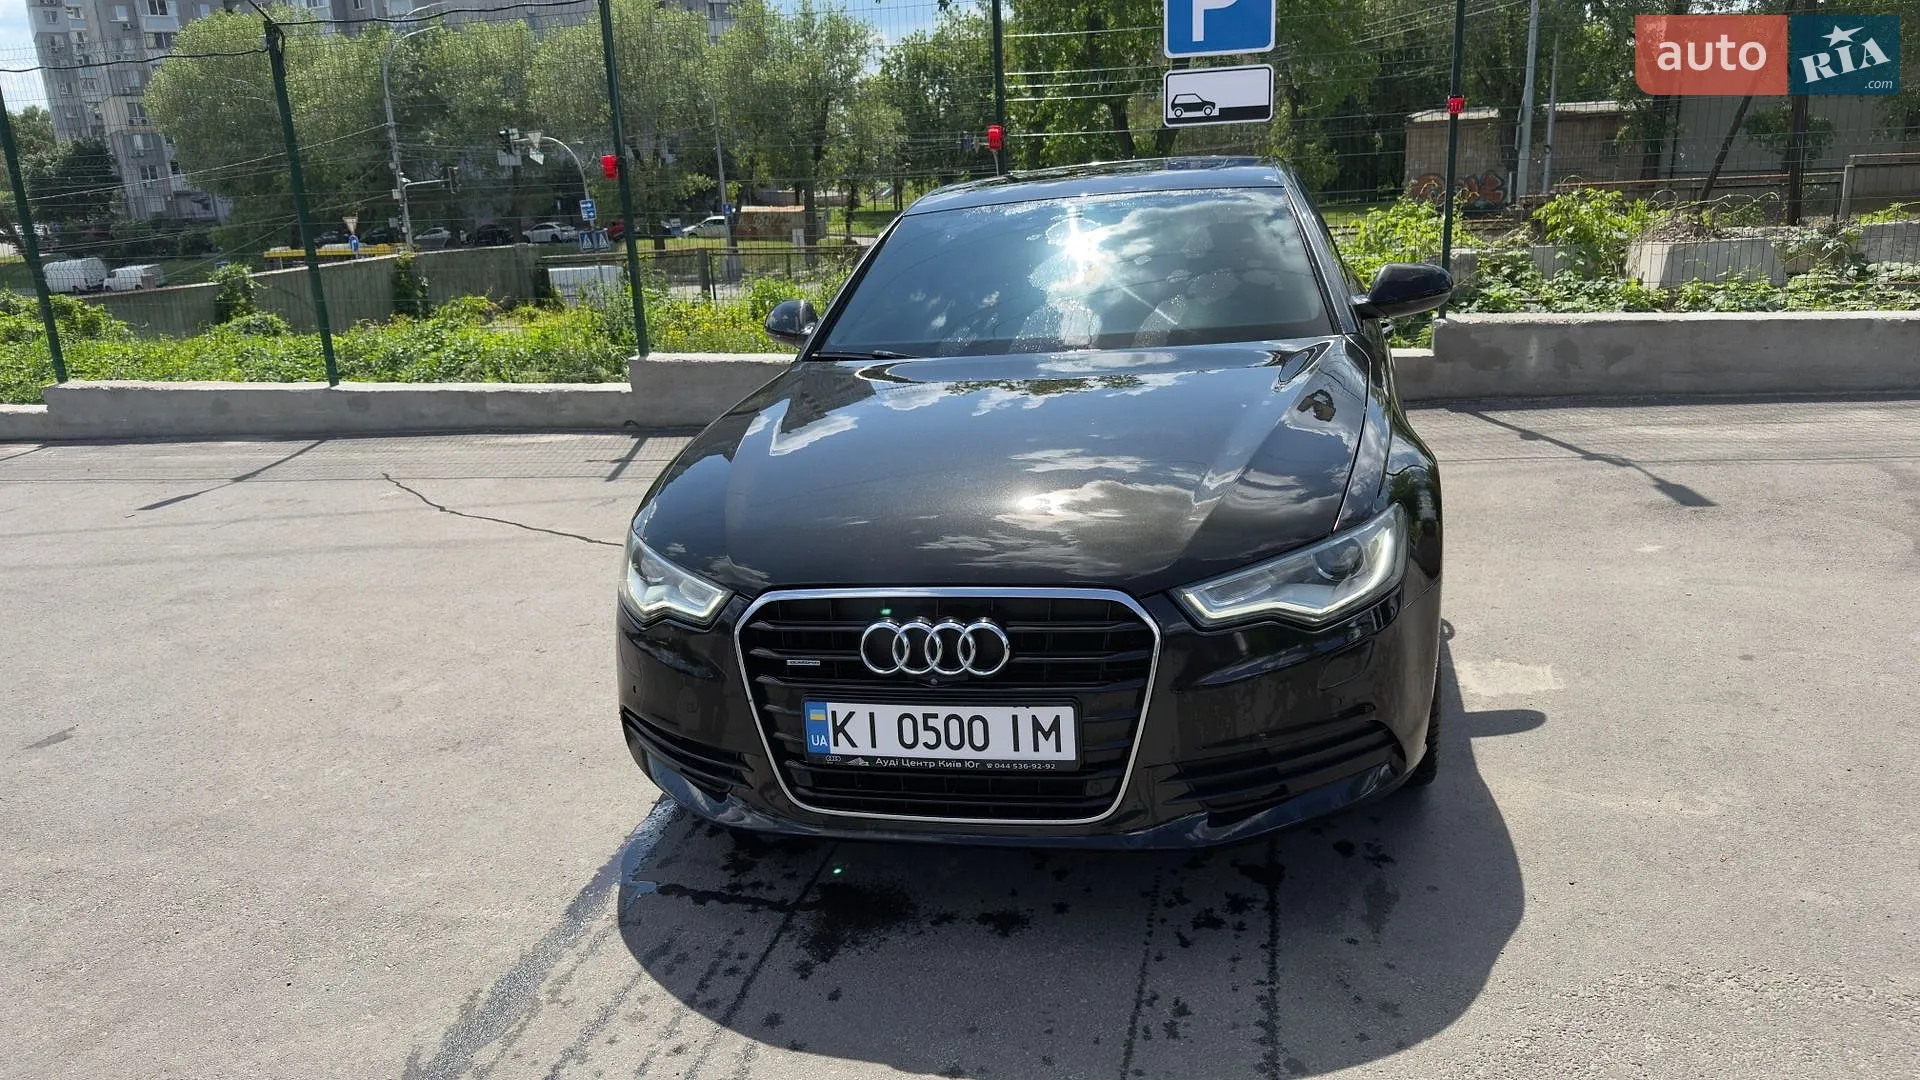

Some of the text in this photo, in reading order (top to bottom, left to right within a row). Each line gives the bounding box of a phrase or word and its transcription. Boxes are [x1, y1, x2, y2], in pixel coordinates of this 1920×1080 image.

[831, 710, 1062, 753] KI 0500 IM
[811, 735, 828, 747] UA
[875, 758, 899, 767] Ауді
[901, 759, 936, 769] Центр
[938, 760, 962, 768] Київ
